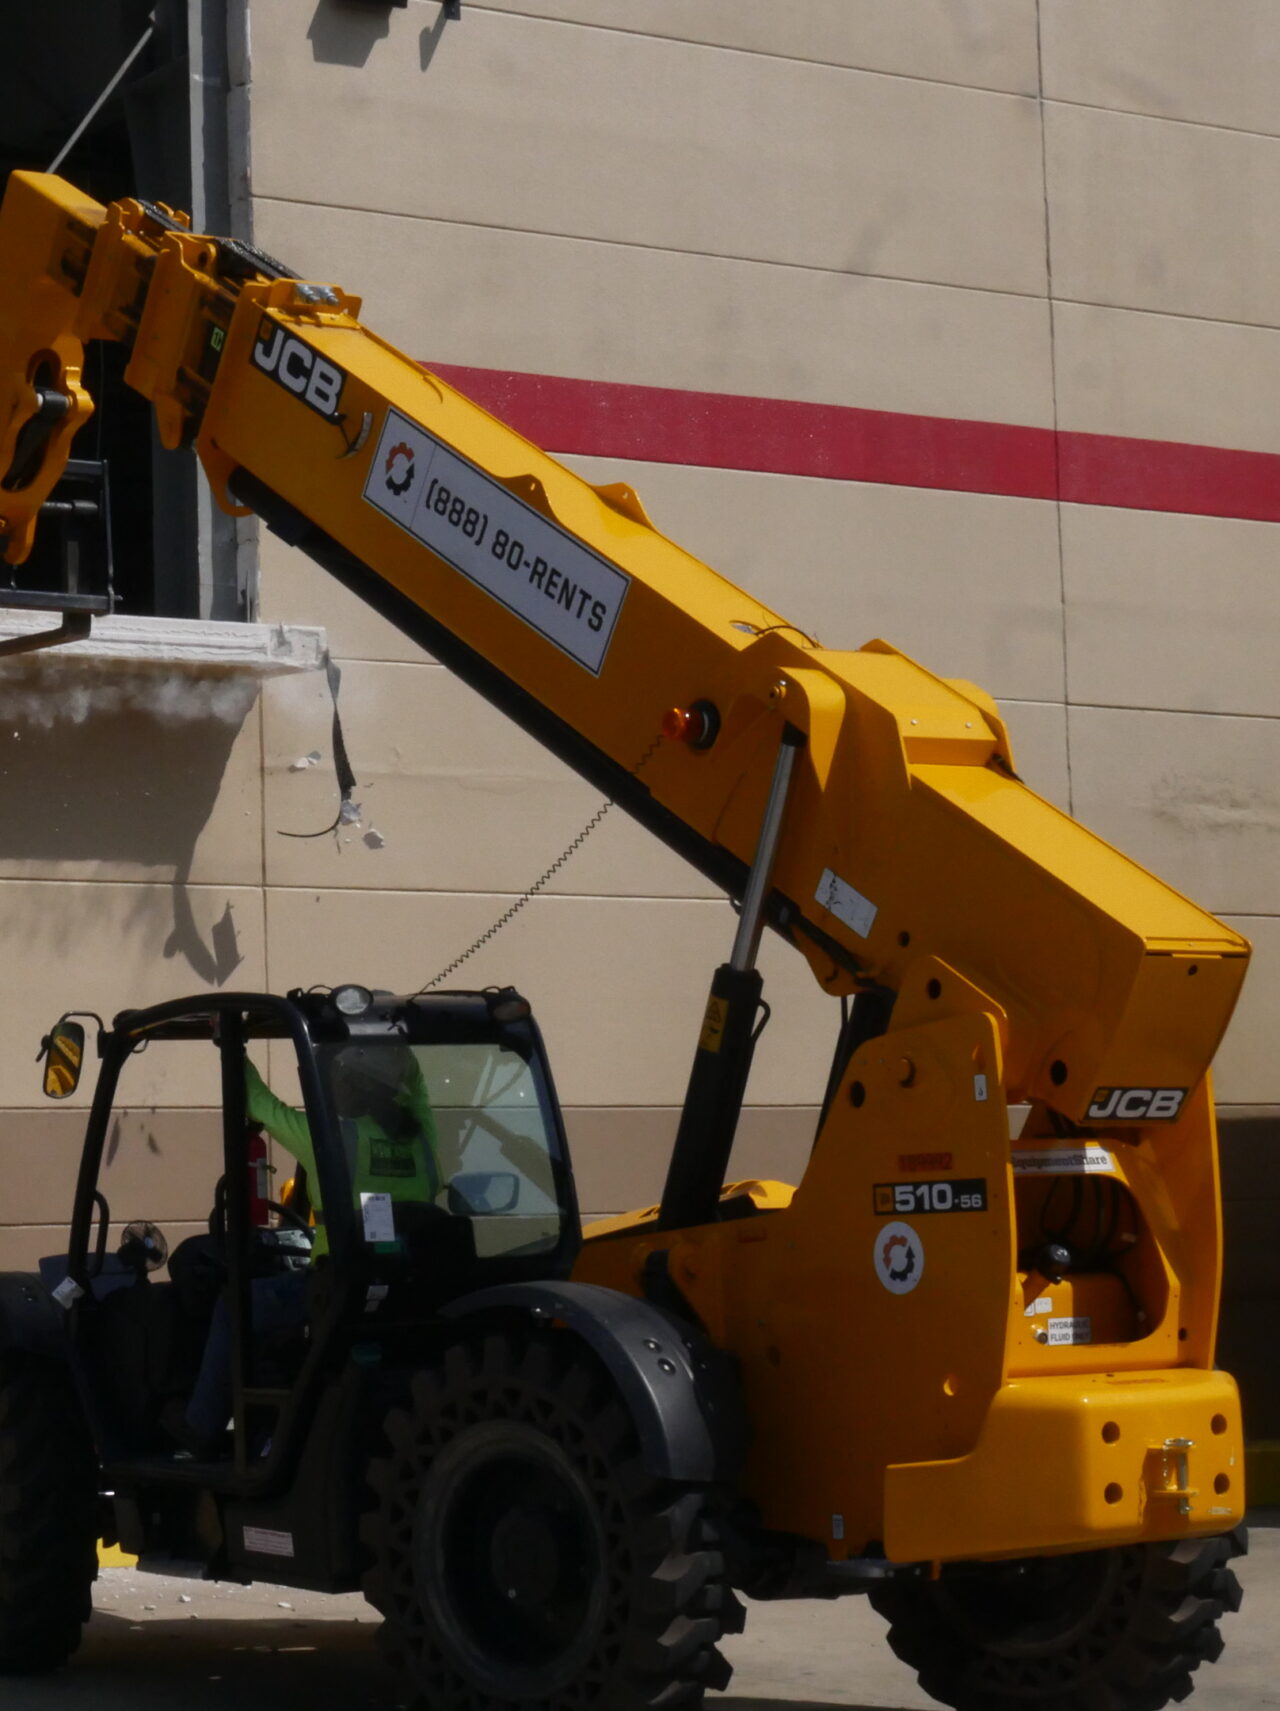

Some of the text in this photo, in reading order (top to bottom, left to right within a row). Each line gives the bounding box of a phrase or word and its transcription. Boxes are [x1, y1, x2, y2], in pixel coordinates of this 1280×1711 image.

[254, 328, 342, 415] JCB
[425, 478, 607, 632] (888) 80-RENTS
[1088, 1089, 1184, 1118] JCB
